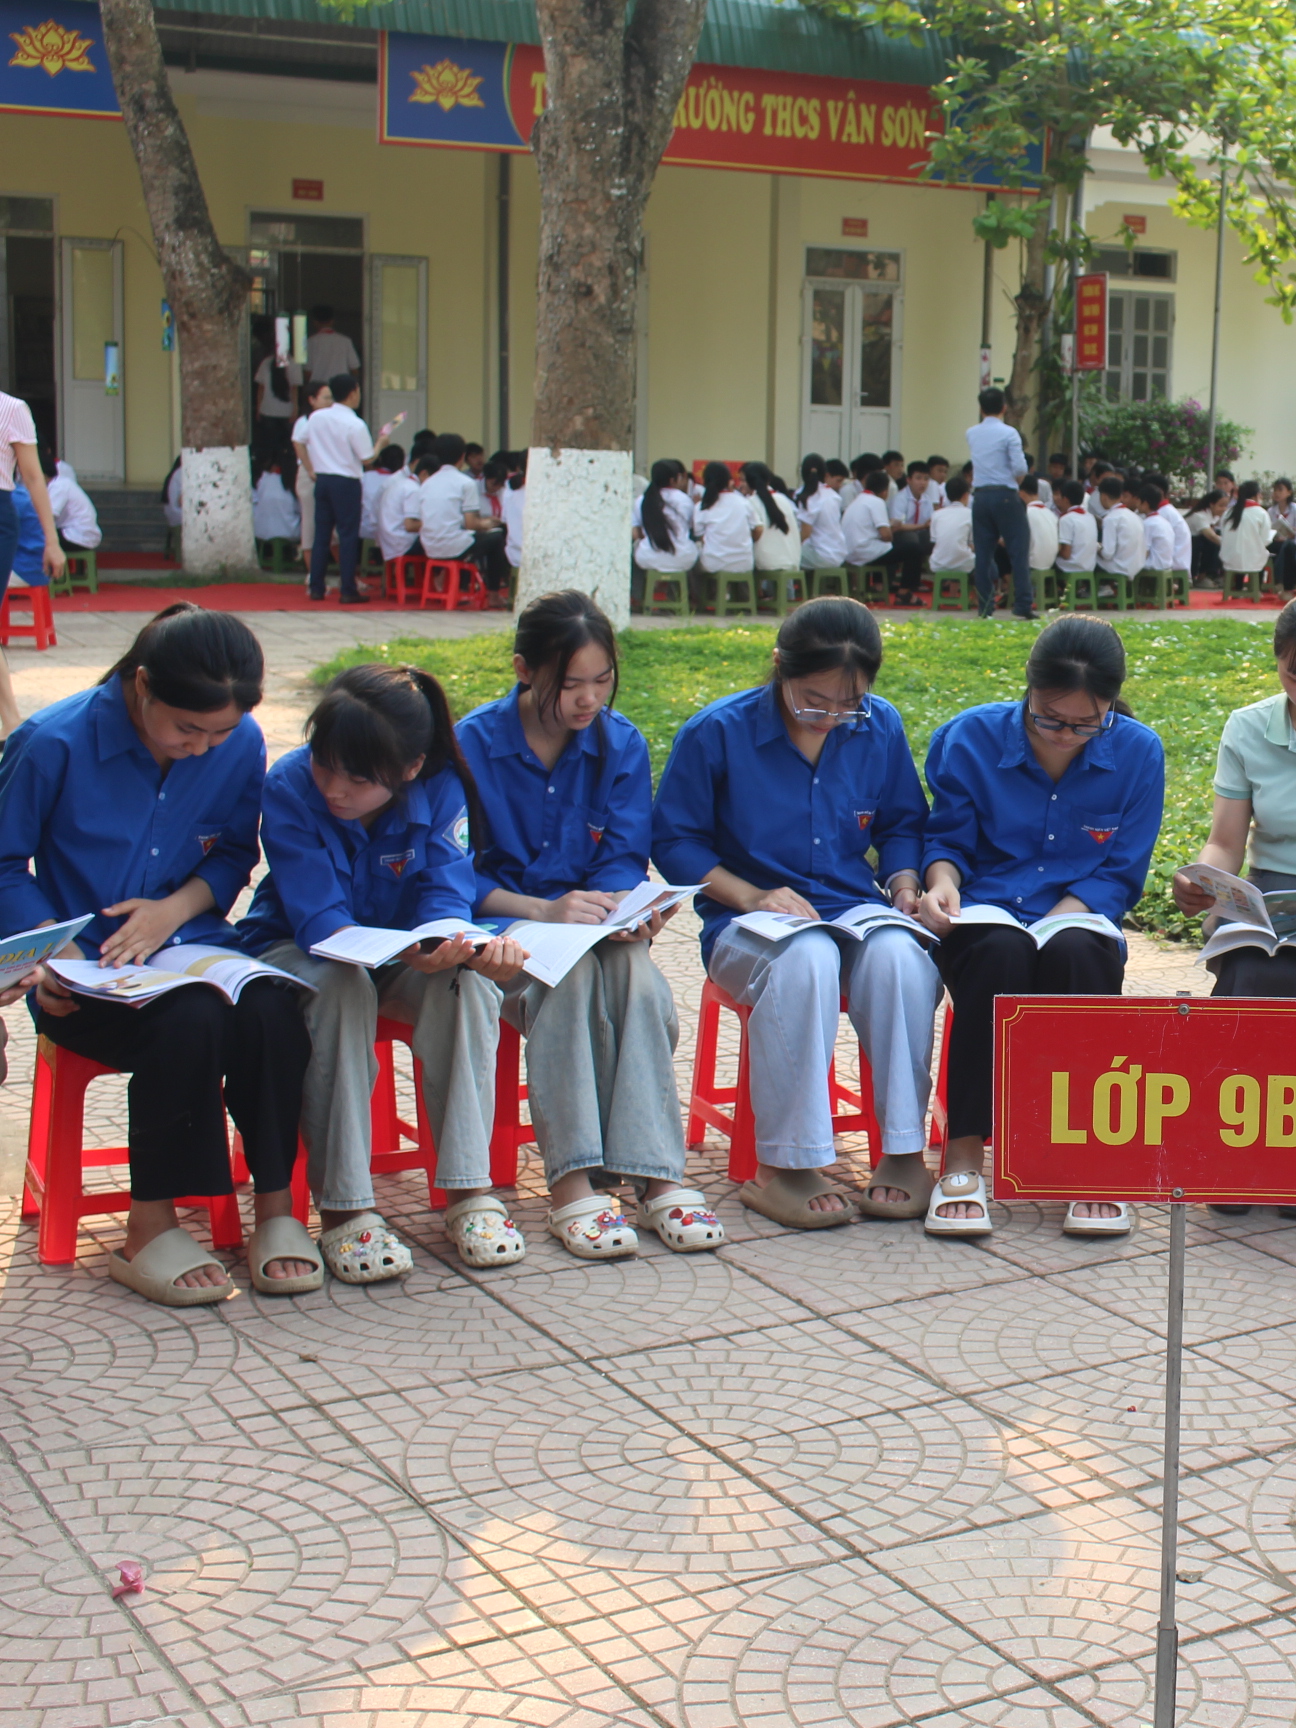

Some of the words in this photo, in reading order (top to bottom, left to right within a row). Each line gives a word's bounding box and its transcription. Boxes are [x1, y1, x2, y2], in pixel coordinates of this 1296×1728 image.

[674, 75, 756, 134] RƯỜNG
[761, 93, 822, 141] THCS
[827, 89, 877, 145] VÂN
[881, 100, 927, 149] SƠN
[1051, 1056, 1191, 1145] LỚP
